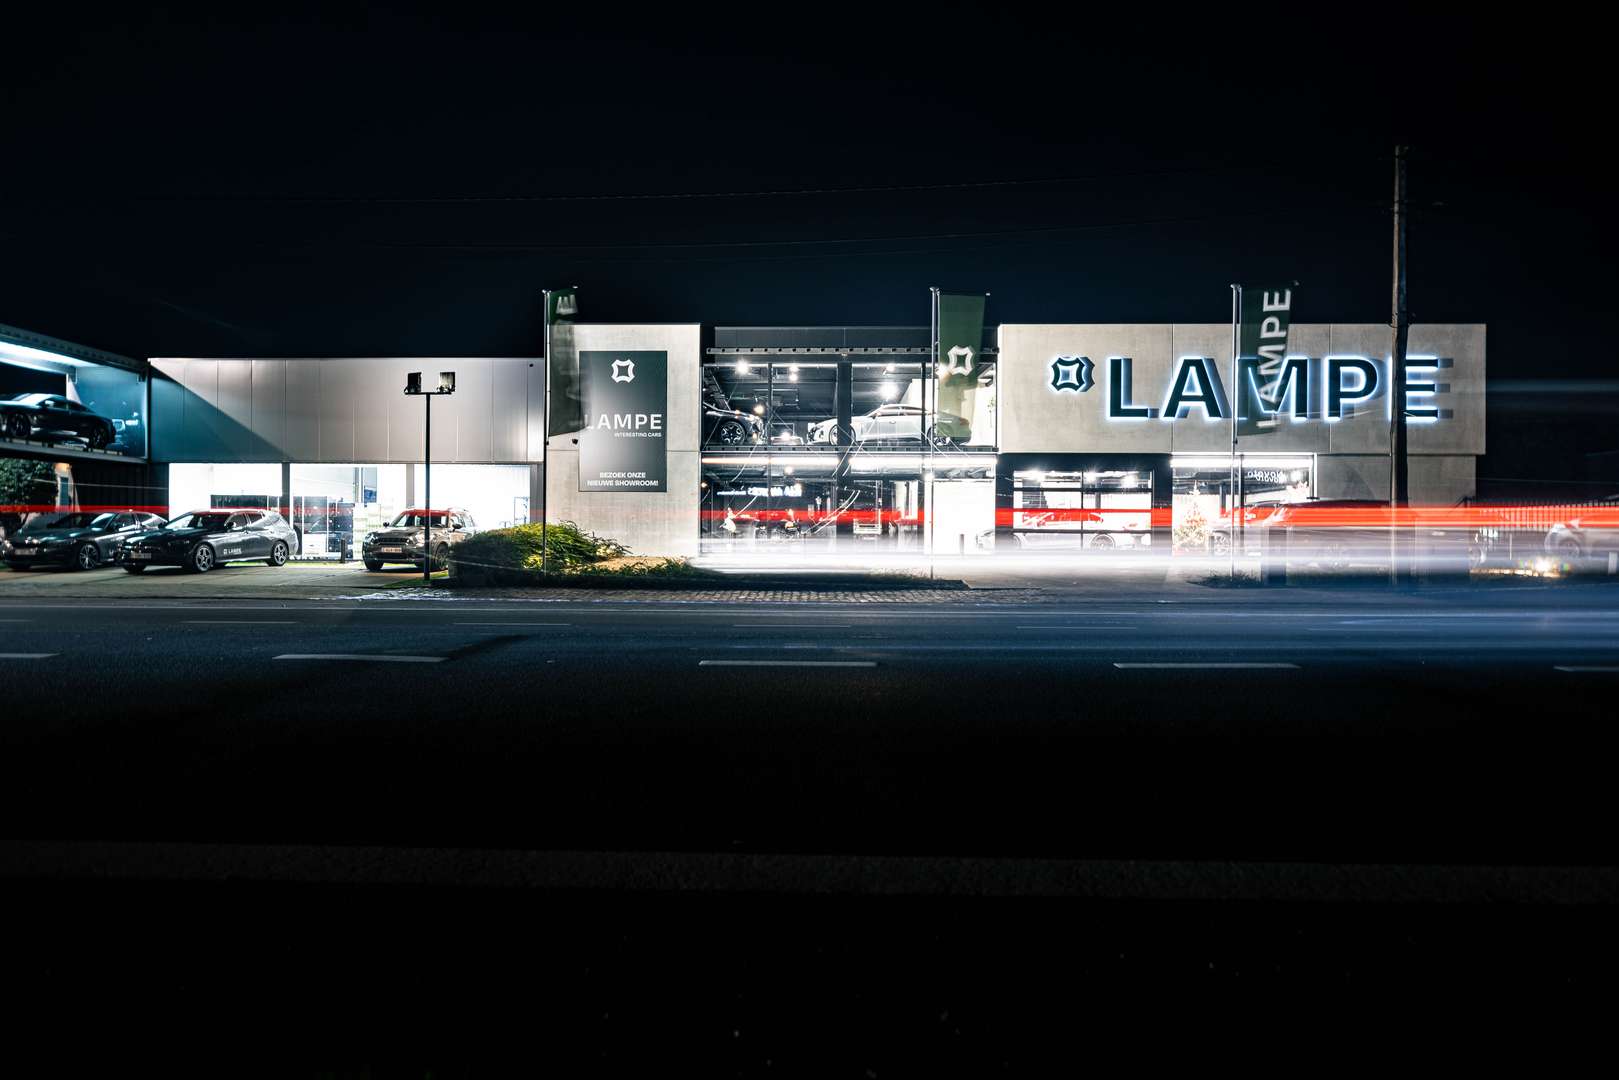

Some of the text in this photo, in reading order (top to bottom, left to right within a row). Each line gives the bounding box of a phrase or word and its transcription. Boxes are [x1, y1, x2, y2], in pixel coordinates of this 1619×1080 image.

[1256, 289, 1292, 428] LAMPE
[1109, 357, 1440, 420] LAMPE
[587, 479, 659, 487] NIEUWE SHOWROOM!
[599, 471, 646, 479] BEZOEK ONZE
